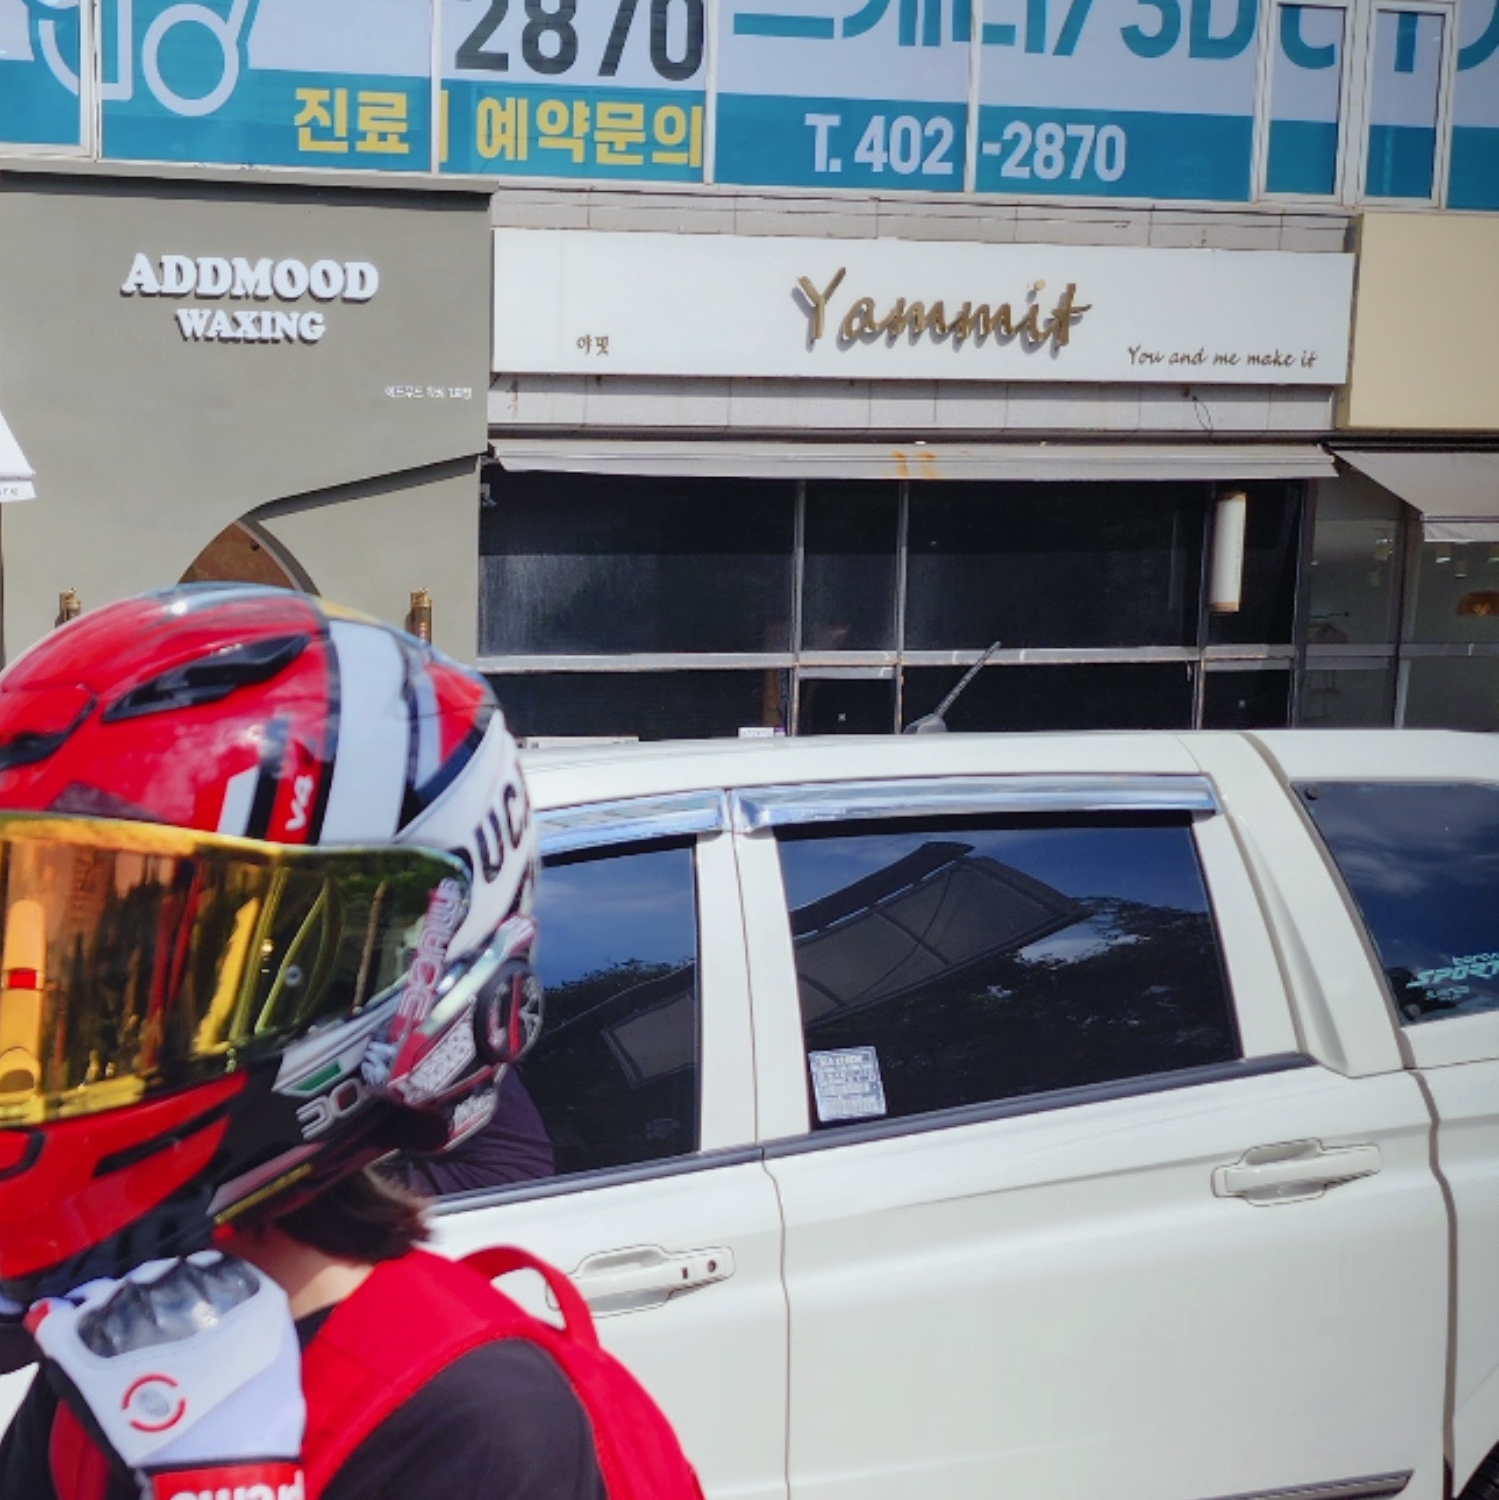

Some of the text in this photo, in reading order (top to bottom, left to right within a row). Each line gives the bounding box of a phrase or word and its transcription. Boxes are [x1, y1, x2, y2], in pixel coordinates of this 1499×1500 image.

[294, 87, 703, 169] 진료 예약문의
[121, 253, 379, 301] ADDMOOD
[176, 308, 326, 343] WAXING
[793, 266, 1093, 353] Yammit
[1127, 344, 1318, 369] You and me make it
